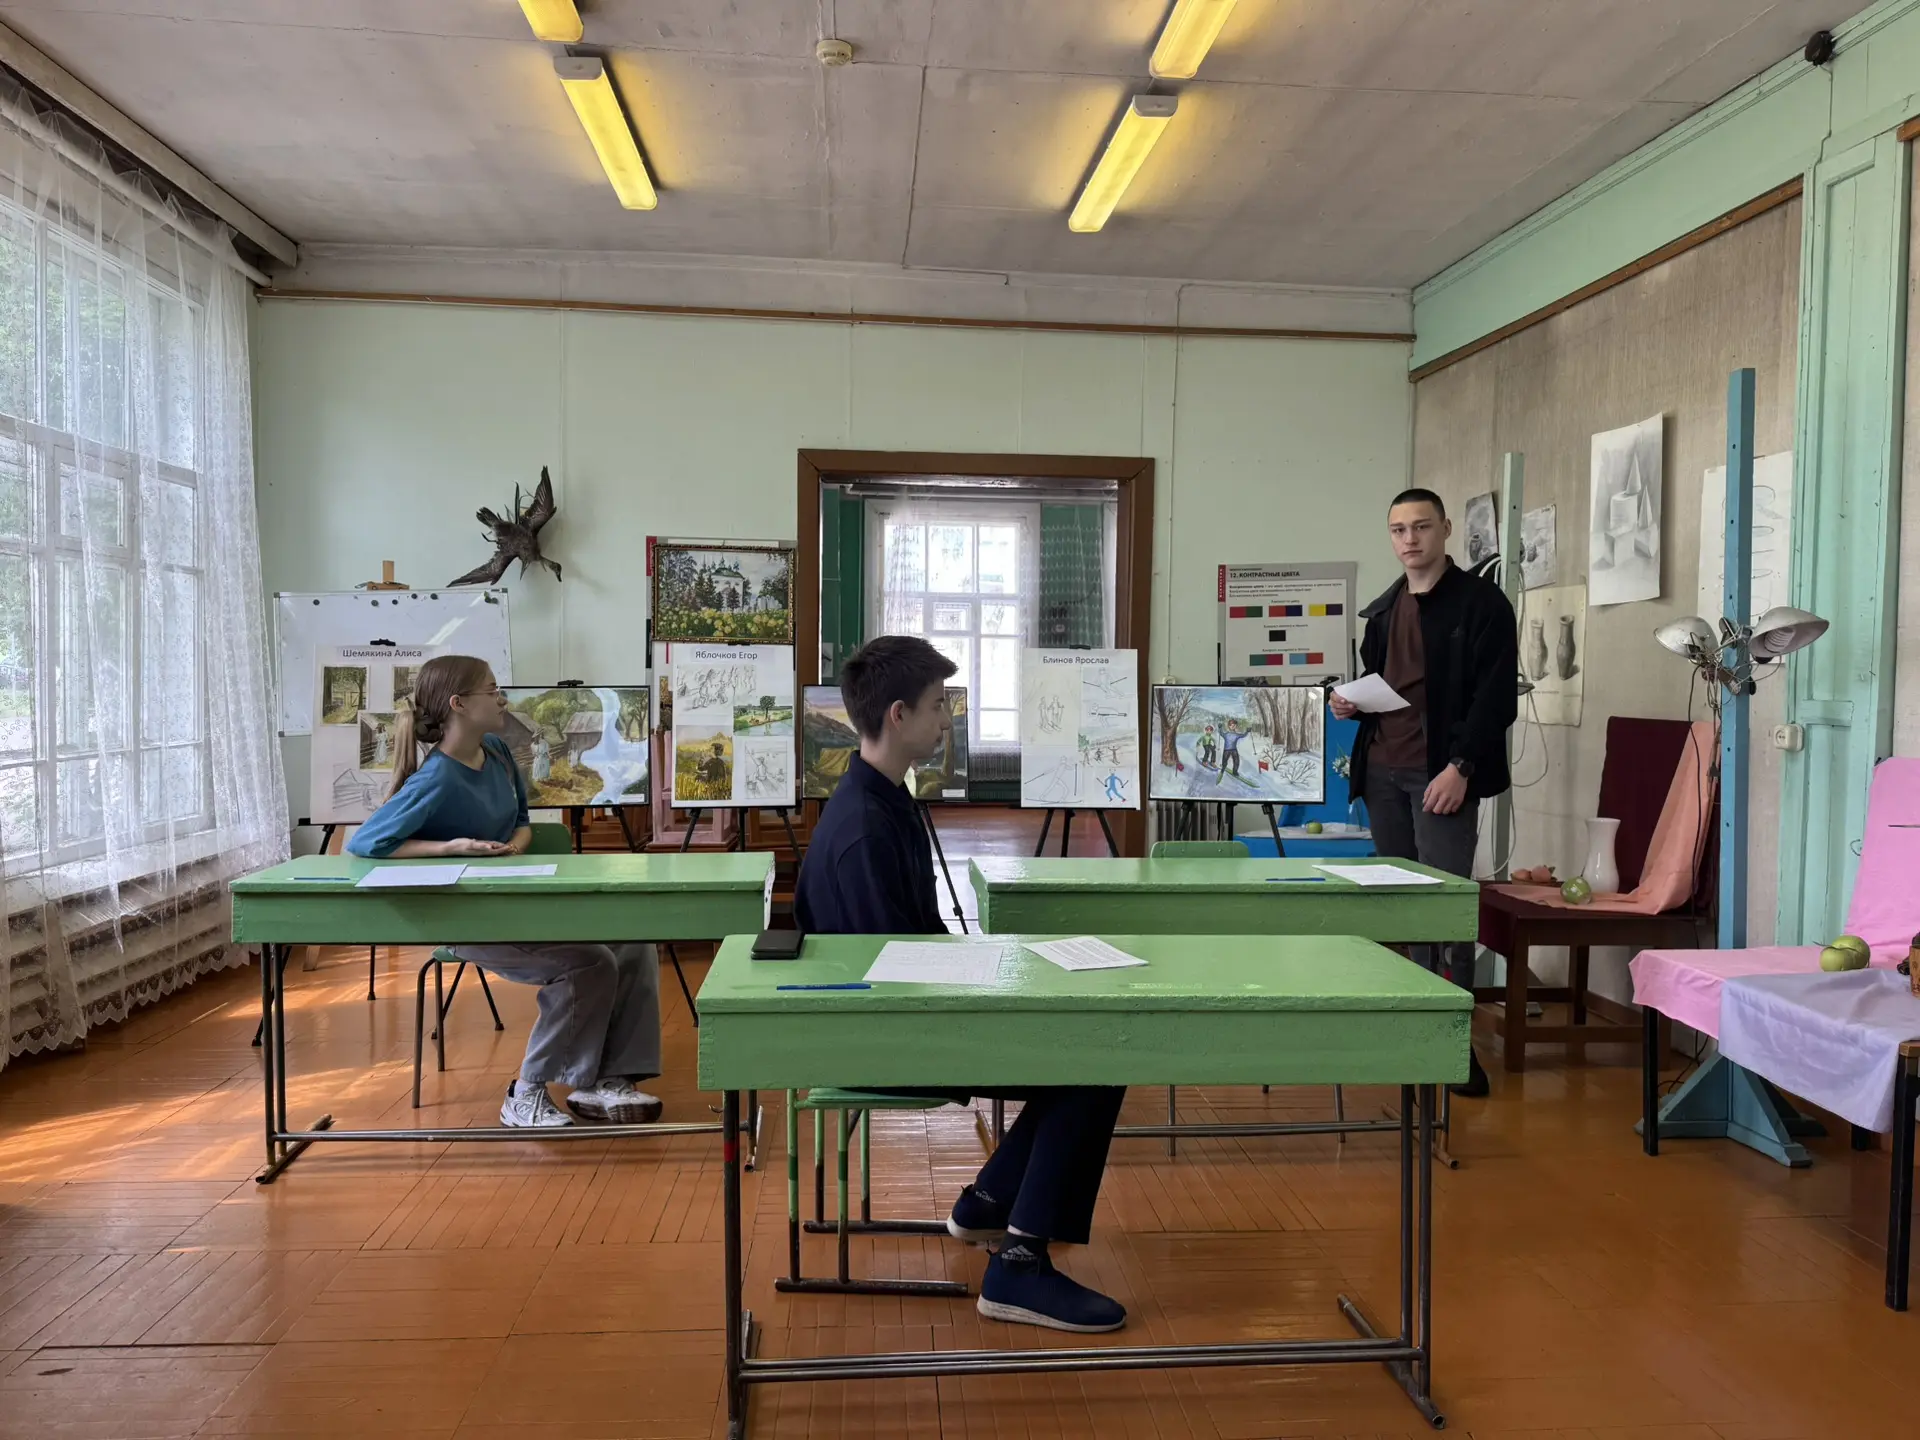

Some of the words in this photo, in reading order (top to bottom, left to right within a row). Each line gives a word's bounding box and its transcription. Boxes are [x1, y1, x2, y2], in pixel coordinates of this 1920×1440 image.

[342, 649, 392, 658] Шемякина
[394, 649, 422, 658] Алиса
[695, 650, 737, 659] Яблочков
[738, 651, 758, 660] Егор
[1042, 655, 1073, 664] Блинов
[1075, 656, 1110, 665] Ярослав
